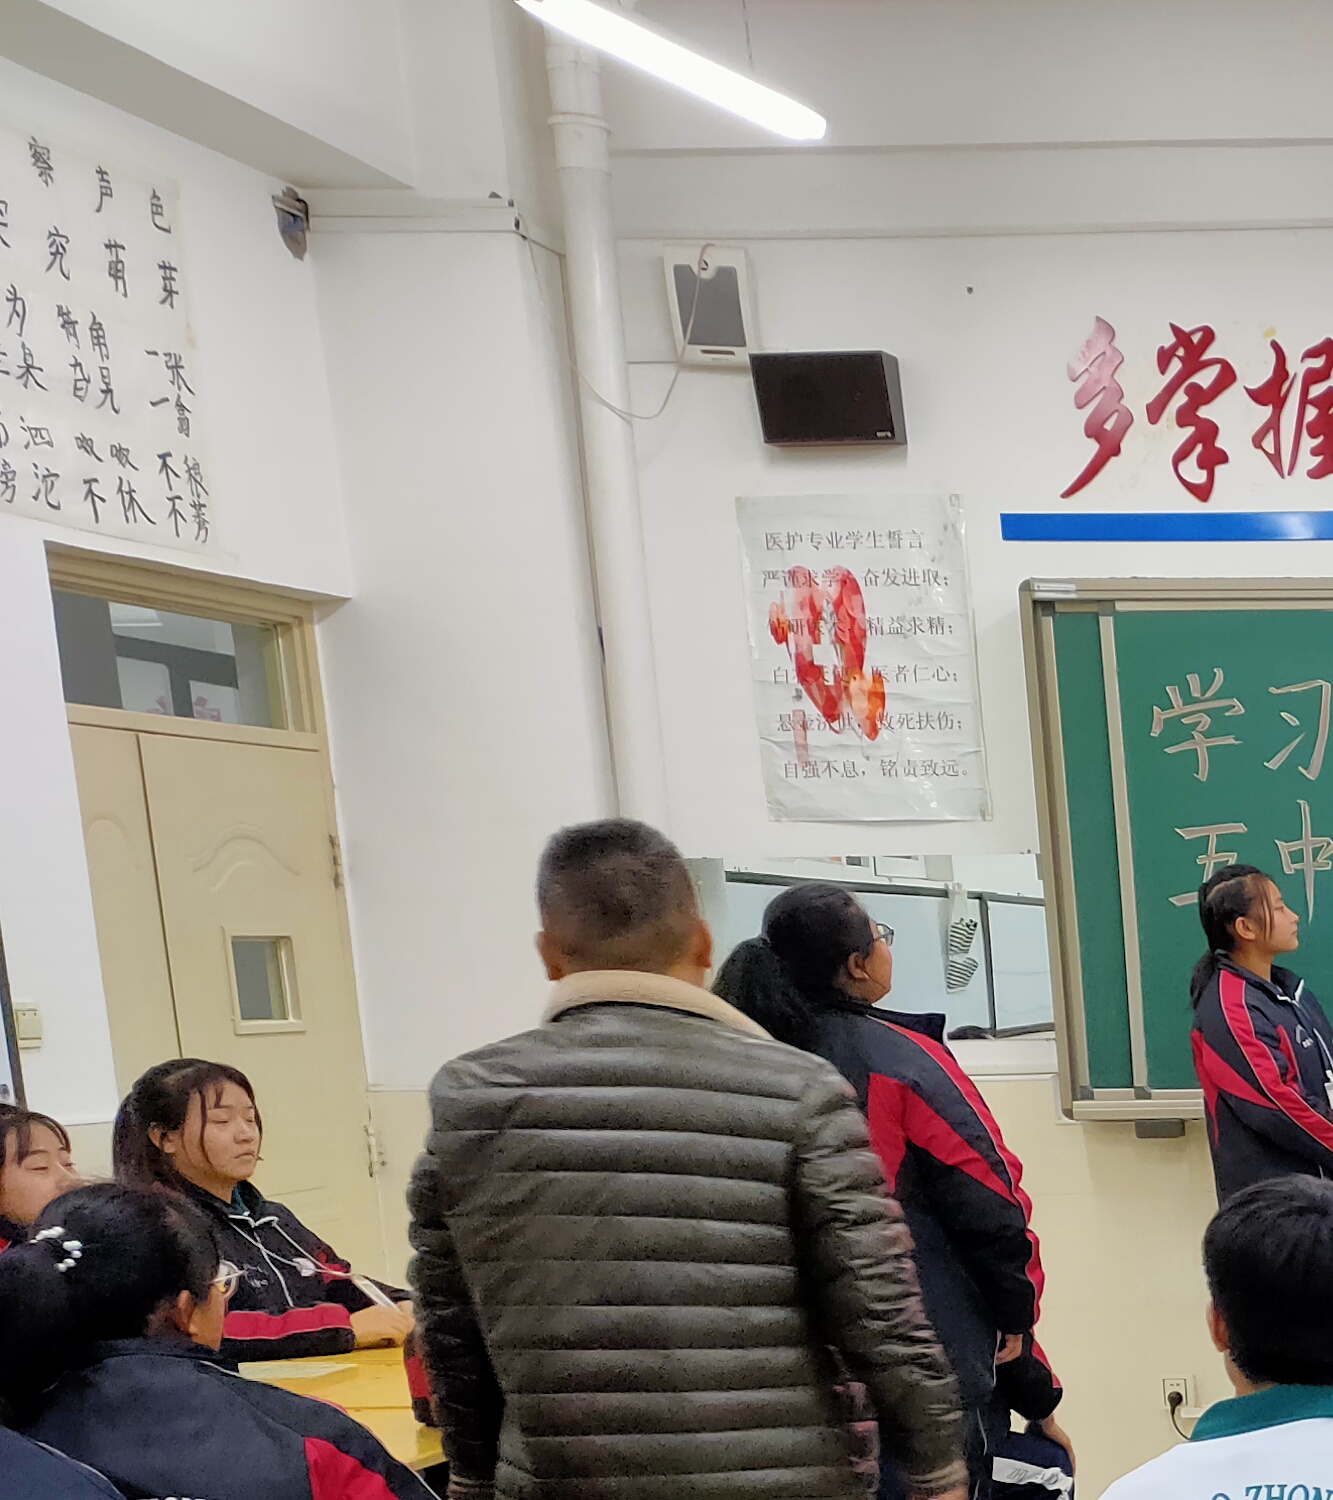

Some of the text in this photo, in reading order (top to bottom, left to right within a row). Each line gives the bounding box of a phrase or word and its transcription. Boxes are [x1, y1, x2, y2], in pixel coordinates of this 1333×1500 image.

[764, 529, 925, 551] 医护专业学生誓言
